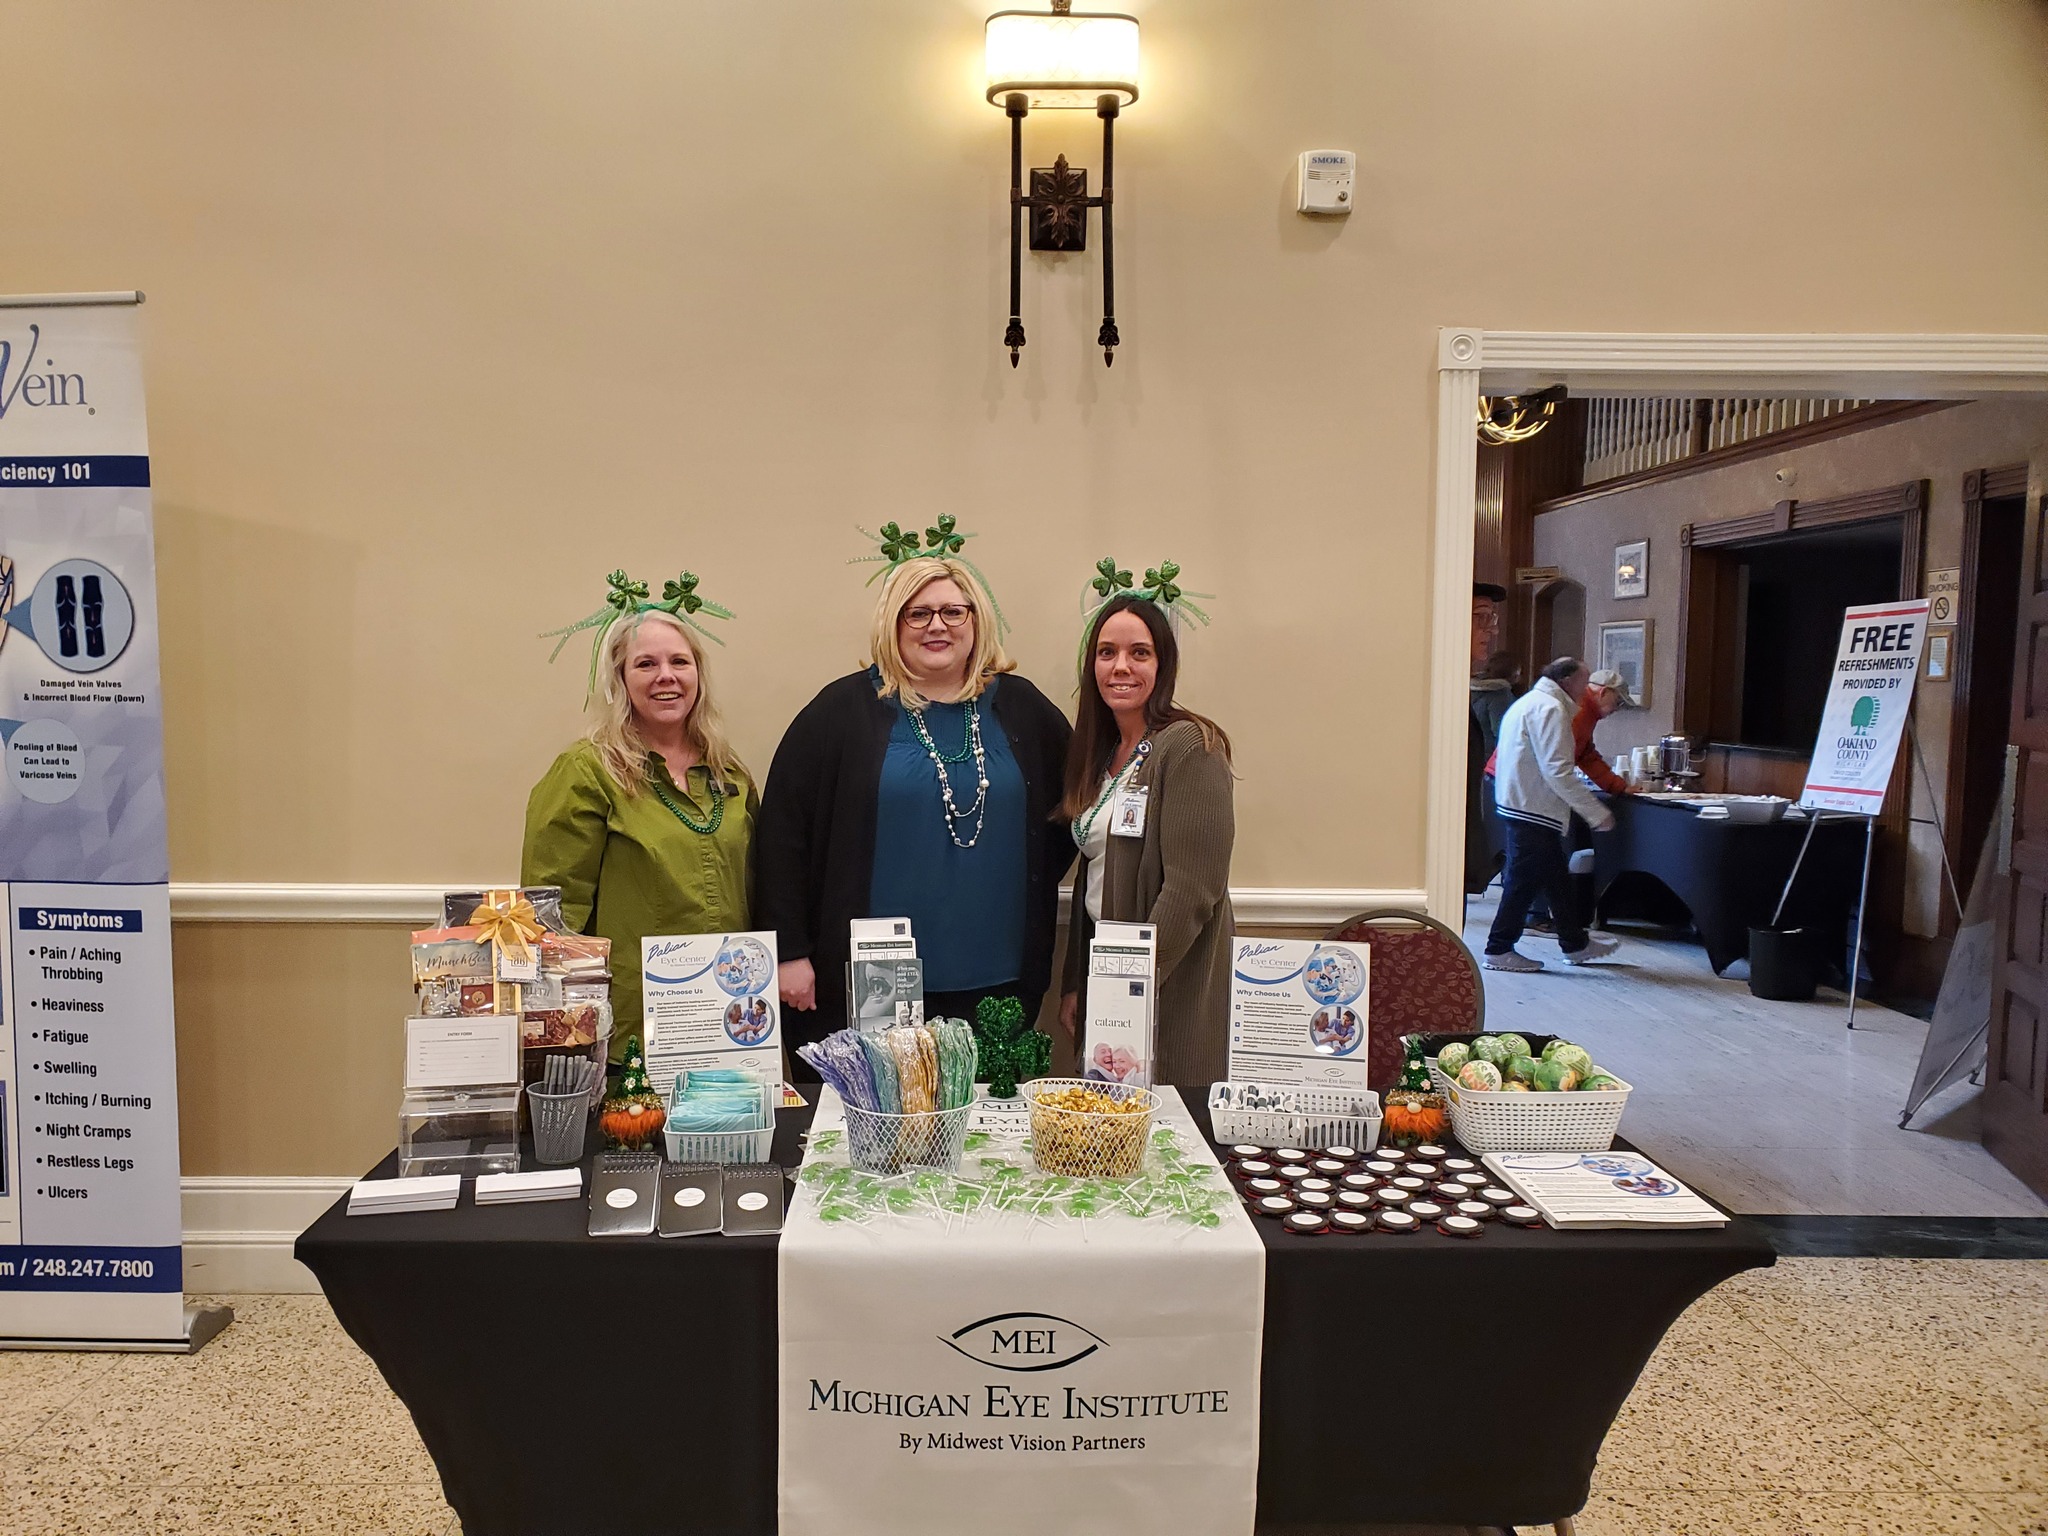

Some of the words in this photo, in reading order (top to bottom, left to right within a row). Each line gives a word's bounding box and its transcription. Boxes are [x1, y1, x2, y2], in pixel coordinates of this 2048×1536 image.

[1312, 156, 1346, 164] SMOKE
[0, 463, 56, 484] ciency
[62, 463, 90, 480] 101
[1939, 573, 1949, 581] NO
[1928, 583, 1959, 593] SMOKING
[1850, 623, 1915, 653] FREE
[1838, 657, 1916, 671] REFRESHMENTS
[40, 680, 75, 689] Damaged
[1843, 678, 1887, 689] PROVIDED
[1888, 678, 1902, 689] BY
[23, 693, 29, 701] &
[32, 693, 68, 702] Incorrect
[70, 694, 91, 702] Blood
[93, 694, 112, 702] Flow
[114, 694, 145, 704] (Down)
[14, 743, 44, 752] Pooling
[46, 743, 54, 751] of
[56, 743, 78, 752] Blood
[1837, 737, 1877, 750] OAKLAND
[23, 757, 39, 765] Can
[41, 757, 60, 765] Lead
[61, 757, 70, 766] to
[1837, 749, 1872, 760] COUNTY
[19, 771, 54, 779] Varicose
[56, 771, 77, 780] Veins
[37, 910, 124, 930] Symptoms
[40, 946, 68, 960] Pain
[71, 946, 77, 960] /
[79, 948, 122, 964] Aching
[647, 941, 694, 963] Balian
[1237, 944, 1284, 962] Balian
[661, 957, 678, 966] Eye
[679, 956, 707, 964] Center
[1250, 958, 1268, 967] Eye
[1269, 959, 1297, 967] Center
[41, 966, 104, 984] Throbbing
[1237, 989, 1252, 997] Why
[42, 997, 105, 1013] Heaviness
[1095, 1018, 1132, 1028] cataract
[43, 1029, 89, 1045] Fatigue
[44, 1060, 98, 1077] Swelling
[45, 1092, 89, 1108] Itching
[92, 1093, 98, 1107] /
[101, 1094, 152, 1110] Burning
[982, 1102, 1028, 1110] MEI
[977, 1116, 1029, 1125] EYE
[46, 1123, 80, 1139] Night
[83, 1124, 132, 1141] Cramps
[47, 1155, 101, 1168] Restless
[104, 1156, 135, 1172] Legs
[48, 1185, 88, 1199] Ulcers
[20, 1258, 28, 1277] /
[32, 1258, 155, 1278] 248.247.7800
[991, 1330, 1057, 1354] MEI
[808, 1379, 971, 1417] MICHIGAN
[983, 1385, 1050, 1418] EYE
[1062, 1387, 1229, 1419] INSTITUTE
[899, 1432, 923, 1455] By
[927, 1432, 1004, 1450] Midwest
[1009, 1434, 1067, 1451] Vision
[1072, 1435, 1146, 1451] Partners
